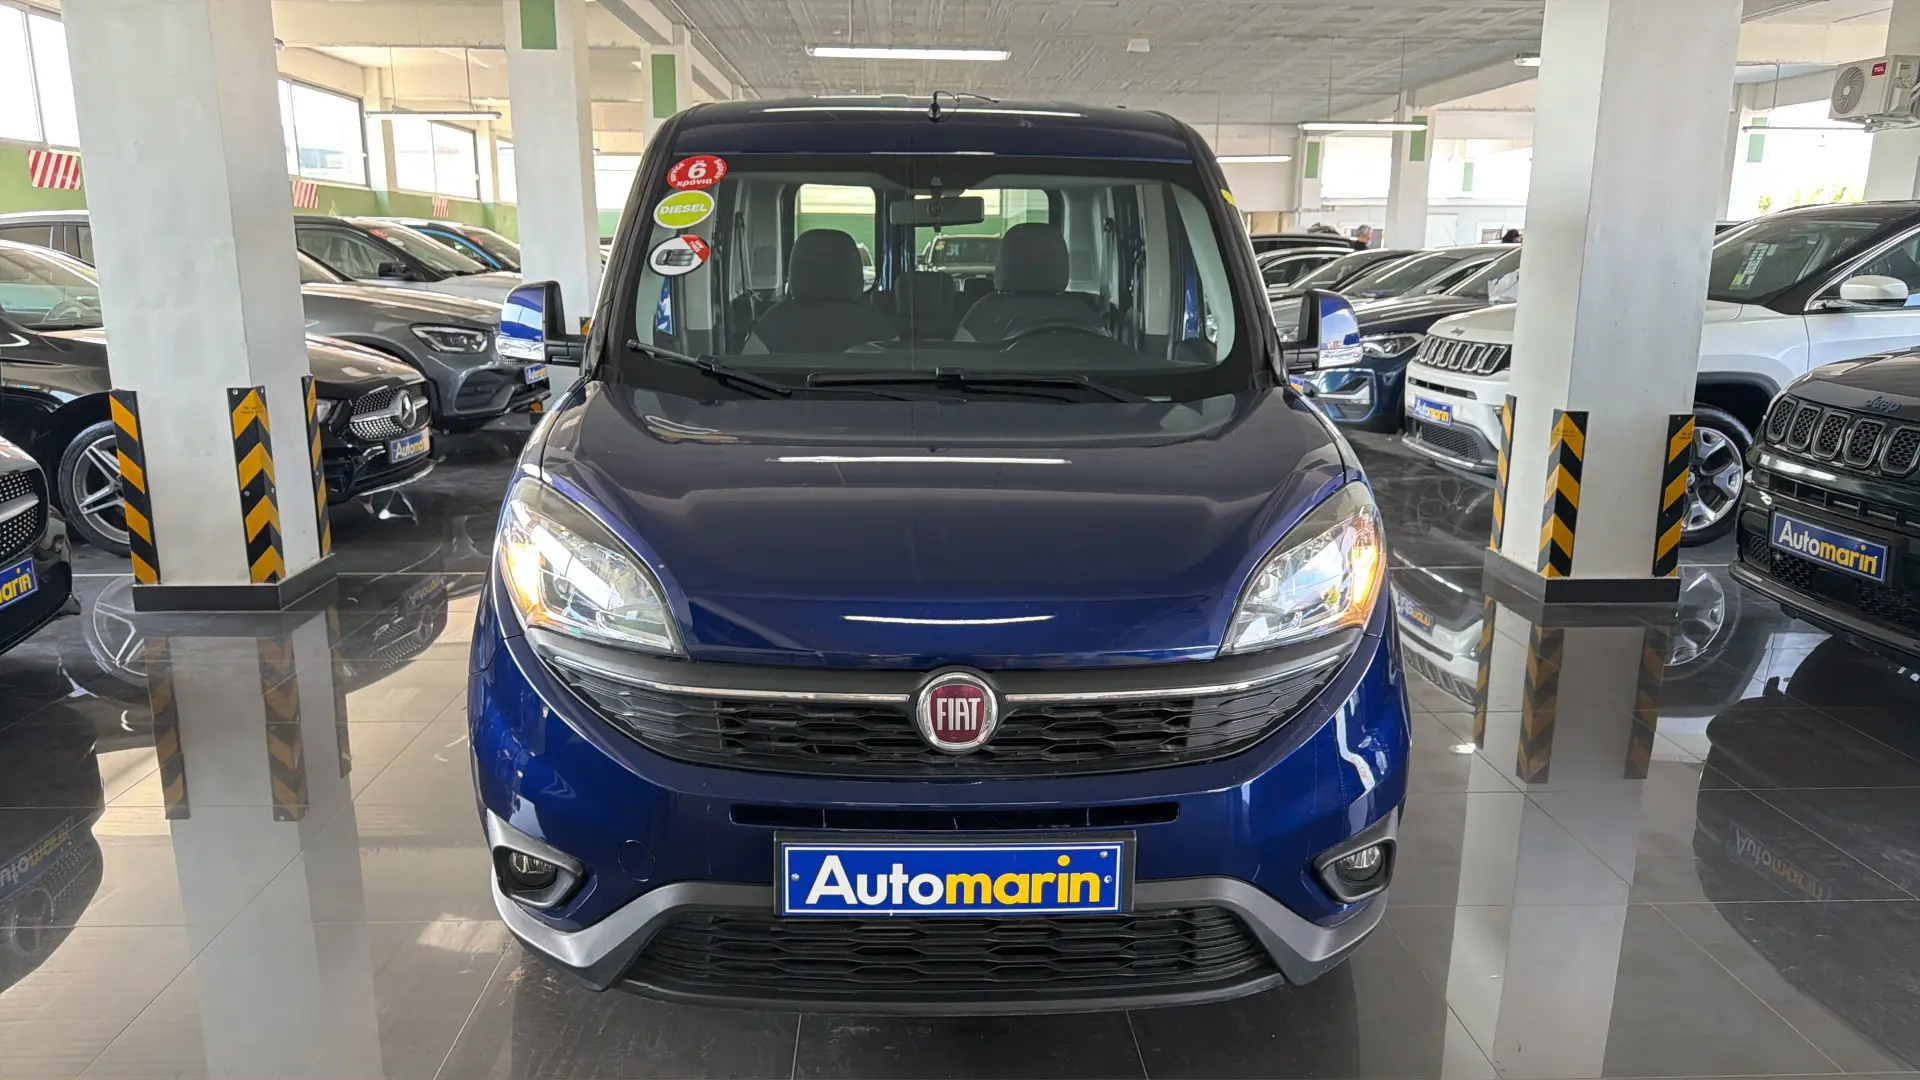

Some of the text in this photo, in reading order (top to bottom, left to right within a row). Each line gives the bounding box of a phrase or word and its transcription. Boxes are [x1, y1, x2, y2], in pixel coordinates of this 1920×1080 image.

[687, 162, 708, 179] 6
[675, 178, 713, 188] χρόνια
[659, 203, 708, 215] DIESEL
[1865, 395, 1902, 413] Jeep
[1778, 520, 1878, 575] Automarin
[936, 697, 981, 731] FIAT
[805, 854, 1101, 906] Automarin
